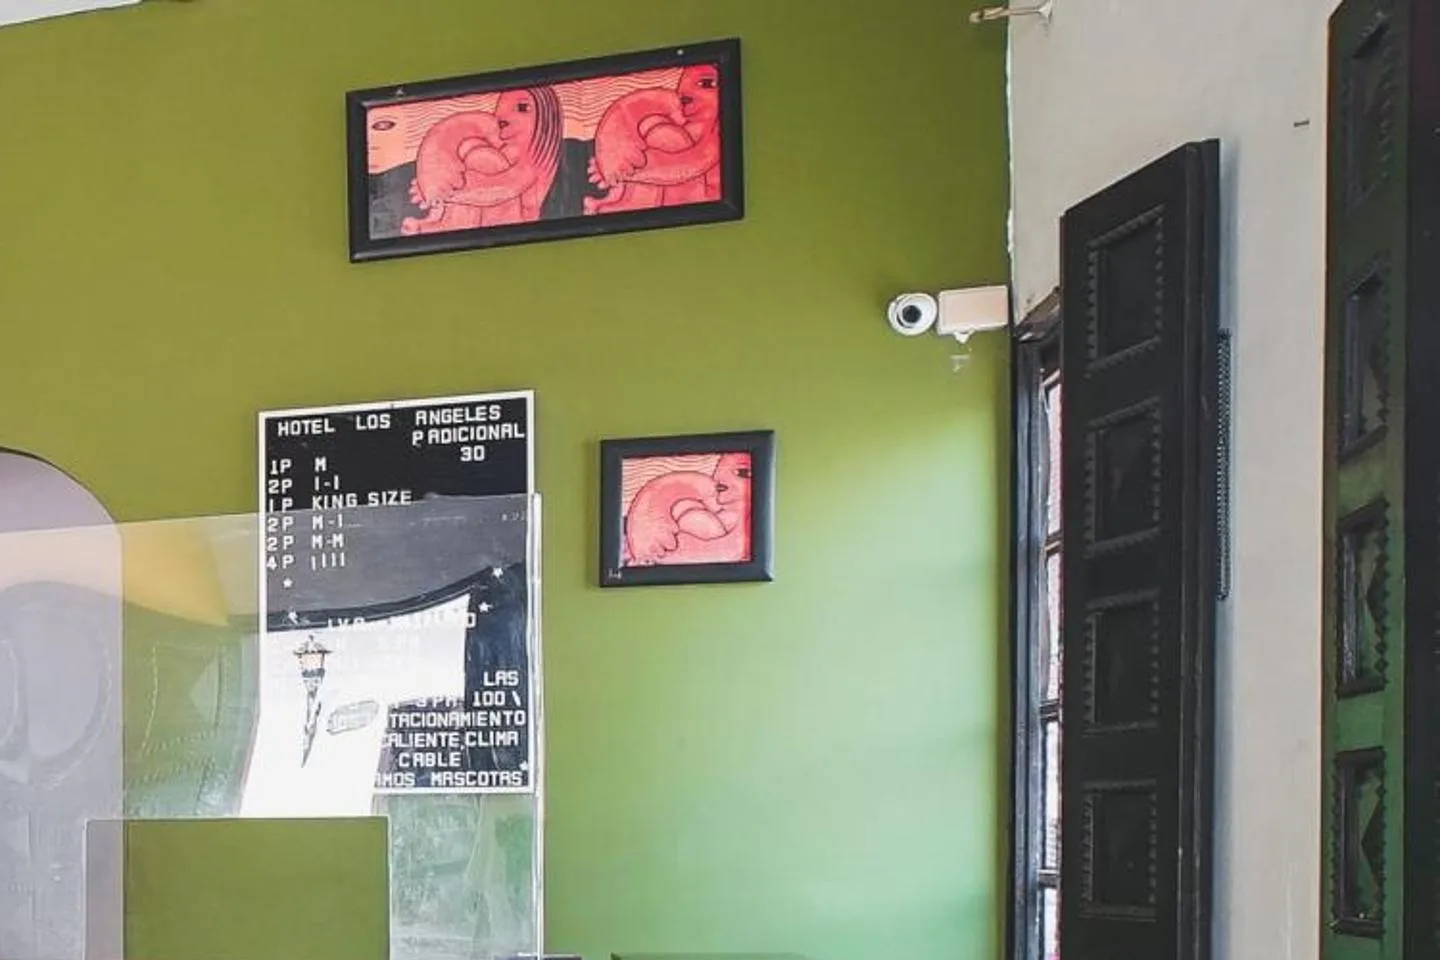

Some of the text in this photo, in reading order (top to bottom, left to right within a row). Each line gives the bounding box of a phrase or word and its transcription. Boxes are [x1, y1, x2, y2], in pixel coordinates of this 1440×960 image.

[277, 404, 501, 437] HOTEL LOS ANGELES
[427, 422, 526, 445] ADICIONAL
[459, 445, 485, 462] 30
[269, 456, 327, 475] 1P M
[312, 493, 358, 511] KING
[367, 490, 412, 507] SIZE
[483, 670, 519, 687] LAS
[472, 690, 506, 707] 100
[398, 752, 461, 768] CABLE
[430, 771, 523, 787] MASCOTAS
